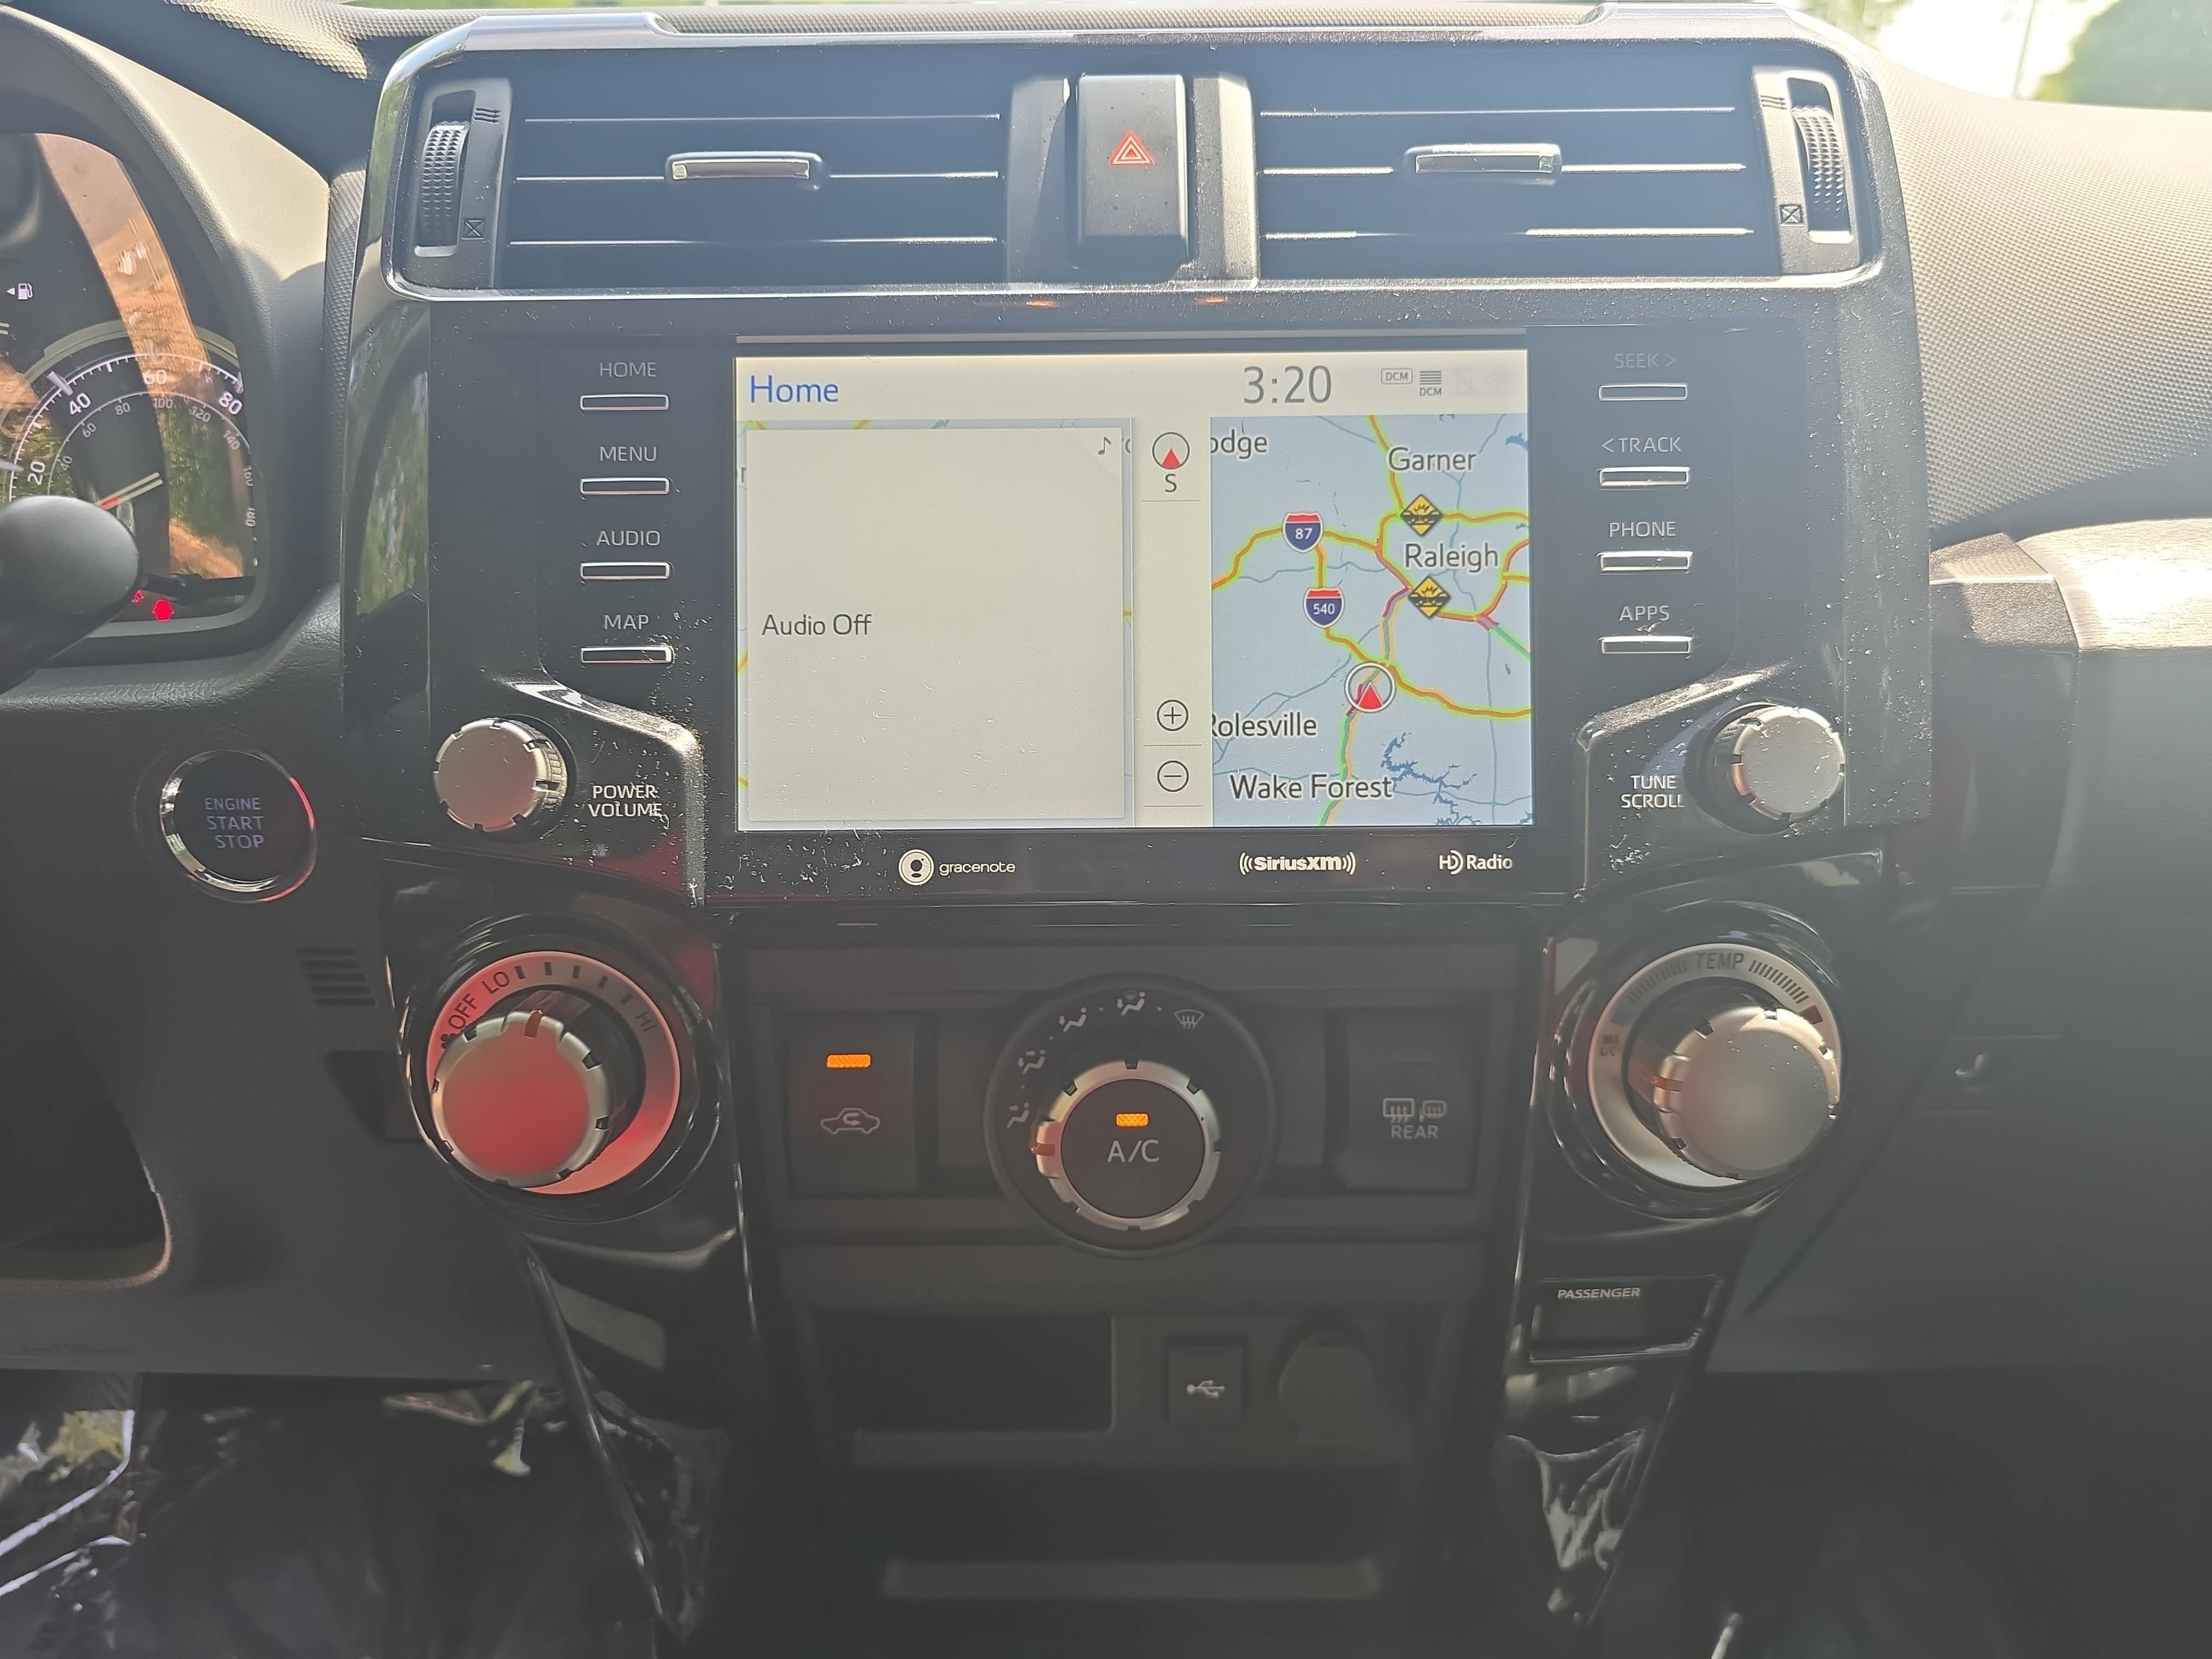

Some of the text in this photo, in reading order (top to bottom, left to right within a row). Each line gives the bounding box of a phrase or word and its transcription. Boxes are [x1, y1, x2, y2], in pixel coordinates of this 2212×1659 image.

[1614, 353, 1659, 369] SEEK
[142, 370, 167, 384] 60
[599, 362, 657, 377] HOME
[1385, 372, 1409, 381] DCM
[750, 375, 839, 403] Home
[1243, 365, 1332, 404] 3:20
[1419, 387, 1442, 396] DCM
[69, 393, 91, 415] 40
[114, 402, 131, 415] 80
[152, 397, 173, 409] 100
[218, 391, 242, 415] 80
[191, 406, 211, 423] 120
[82, 422, 97, 438] 60
[223, 430, 241, 451] 140
[1618, 436, 1681, 452] TRACK
[600, 446, 657, 462] MENU
[1388, 447, 1476, 471] Garner
[60, 455, 73, 472] 40
[27, 461, 46, 486] 20
[1165, 473, 1177, 493] S
[1295, 528, 1312, 539] 87
[1609, 521, 1676, 537] PHONE
[596, 529, 661, 546] AUDIO
[1404, 544, 1499, 572] Raleigh
[1313, 603, 1335, 615] 540
[1619, 605, 1670, 621] APPS
[604, 614, 650, 629] MAP
[761, 614, 872, 636] Audio Off
[1231, 774, 1392, 799] Wake Forest
[1630, 775, 1676, 789] TUNE
[593, 785, 657, 799] POWER
[205, 798, 262, 811] ENGINE
[1621, 794, 1684, 808] SCROLL
[587, 803, 662, 817] VOLUME
[207, 816, 264, 830] START
[215, 834, 264, 848] STOP
[939, 861, 1016, 876] gracenote
[1467, 854, 1513, 870] Radio
[1695, 953, 1744, 970] TEMP
[482, 970, 510, 994] LO
[448, 993, 478, 1030] OFF
[1391, 1125, 1438, 1140] REAR
[1107, 1140, 1160, 1163] A/C
[1557, 1287, 1641, 1299] PASSENGER
